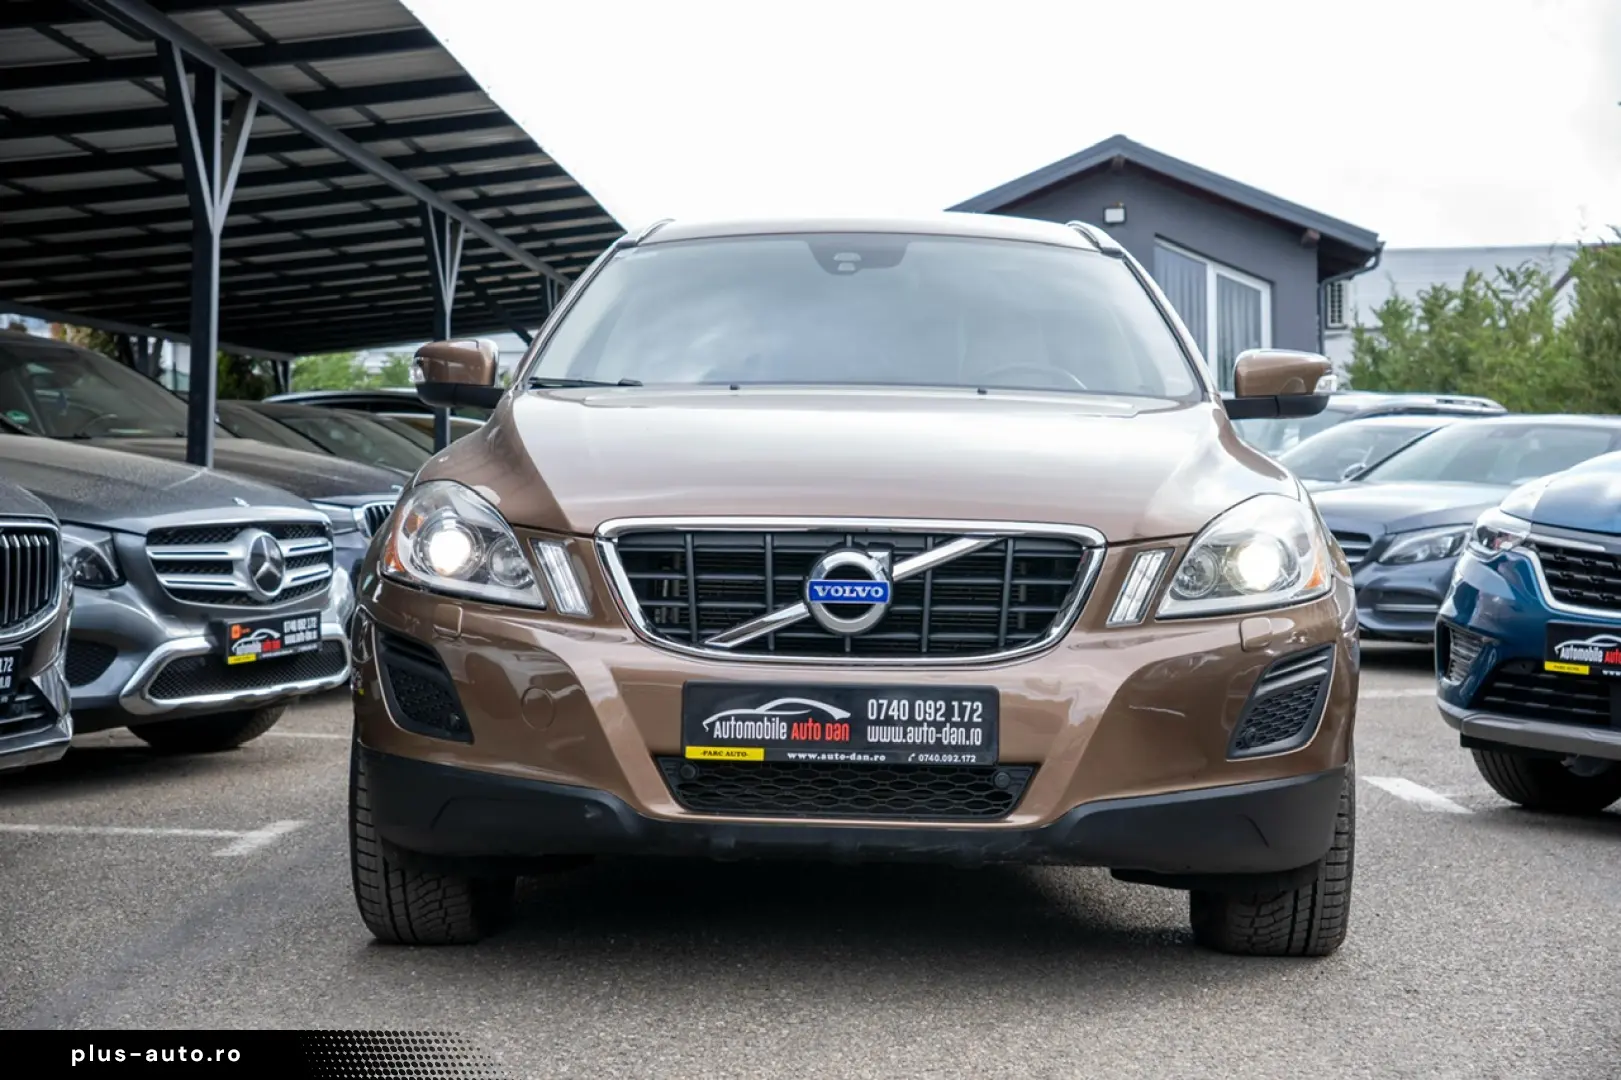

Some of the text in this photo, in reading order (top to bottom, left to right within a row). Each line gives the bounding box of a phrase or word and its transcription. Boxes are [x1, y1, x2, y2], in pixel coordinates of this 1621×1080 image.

[813, 585, 884, 598] VOLVO
[867, 698, 983, 723] 0740 092 172
[713, 716, 788, 740] Automobile
[791, 717, 821, 741] Auto
[867, 722, 983, 746] www.auto-dan.ro
[787, 751, 886, 762] www.auto-dan.ro
[918, 753, 976, 763] 0740.092.172
